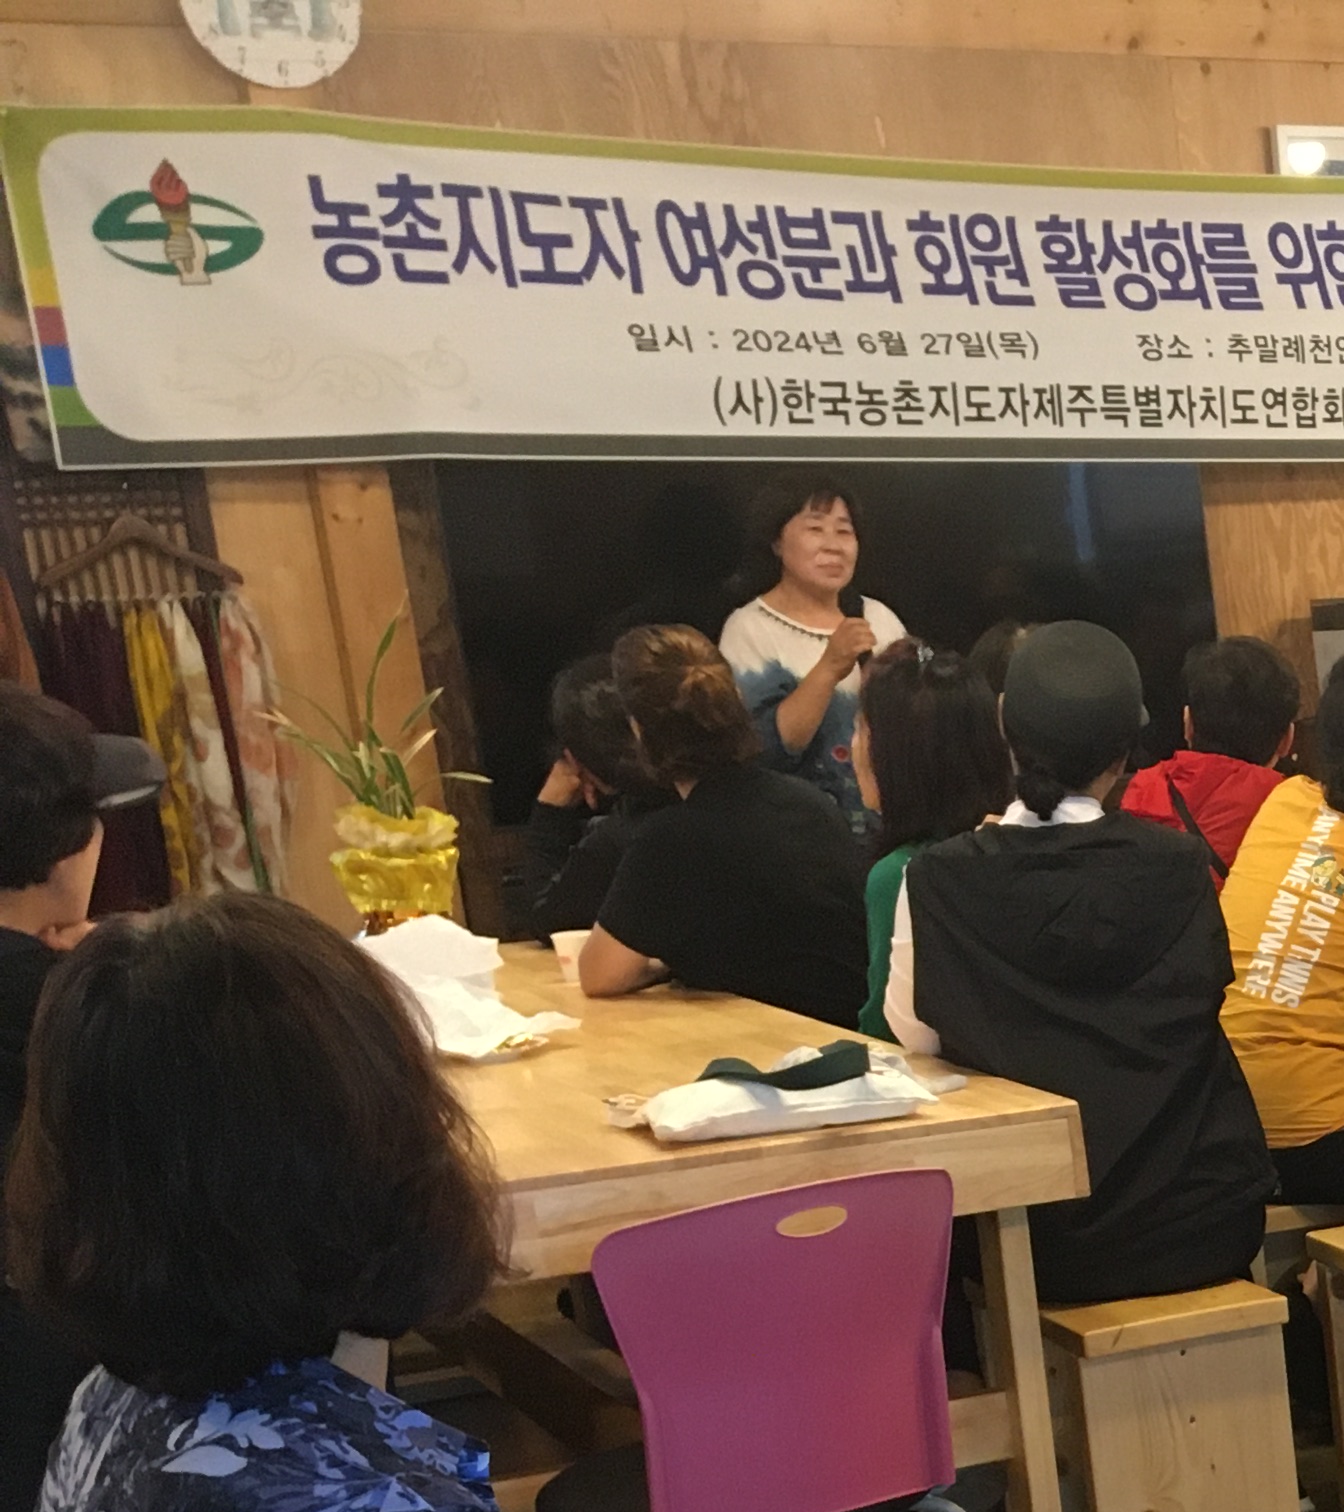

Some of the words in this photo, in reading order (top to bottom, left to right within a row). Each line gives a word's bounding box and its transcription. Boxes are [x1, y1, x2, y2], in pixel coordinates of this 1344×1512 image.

[307, 173, 644, 294] 농촌지도자
[655, 198, 904, 304] 여성분과
[905, 210, 1036, 306] 회원
[1035, 214, 1264, 311] 활성화를
[627, 322, 694, 354] 일시
[732, 329, 845, 355] 2024년
[857, 330, 909, 357] 6월
[920, 331, 1040, 360] 27일(목)
[1136, 333, 1194, 362] 장소
[1297, 889, 1341, 945] PLAY
[1271, 944, 1322, 1008] TNNIS
